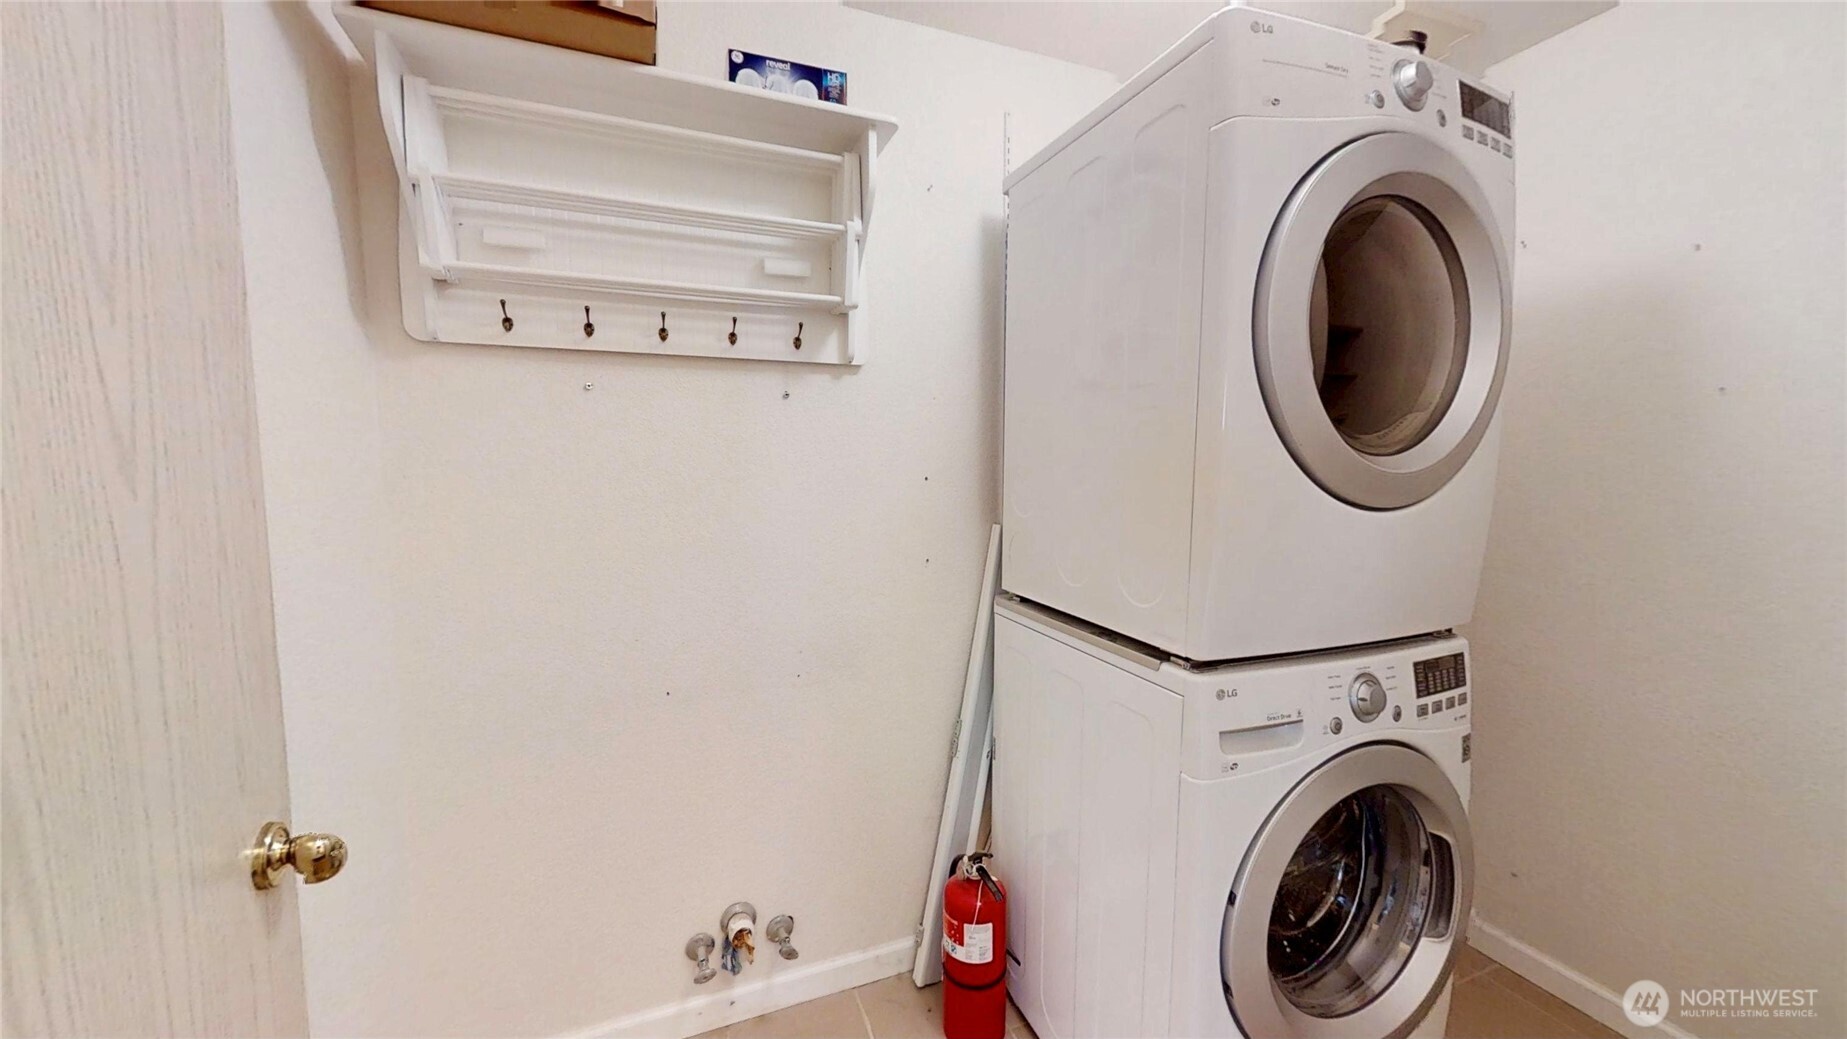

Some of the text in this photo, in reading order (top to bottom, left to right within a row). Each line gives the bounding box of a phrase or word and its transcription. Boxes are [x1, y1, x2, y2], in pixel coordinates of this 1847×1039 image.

[1262, 23, 1274, 34] LG
[765, 59, 791, 71] reveal
[1227, 688, 1238, 698] LG
